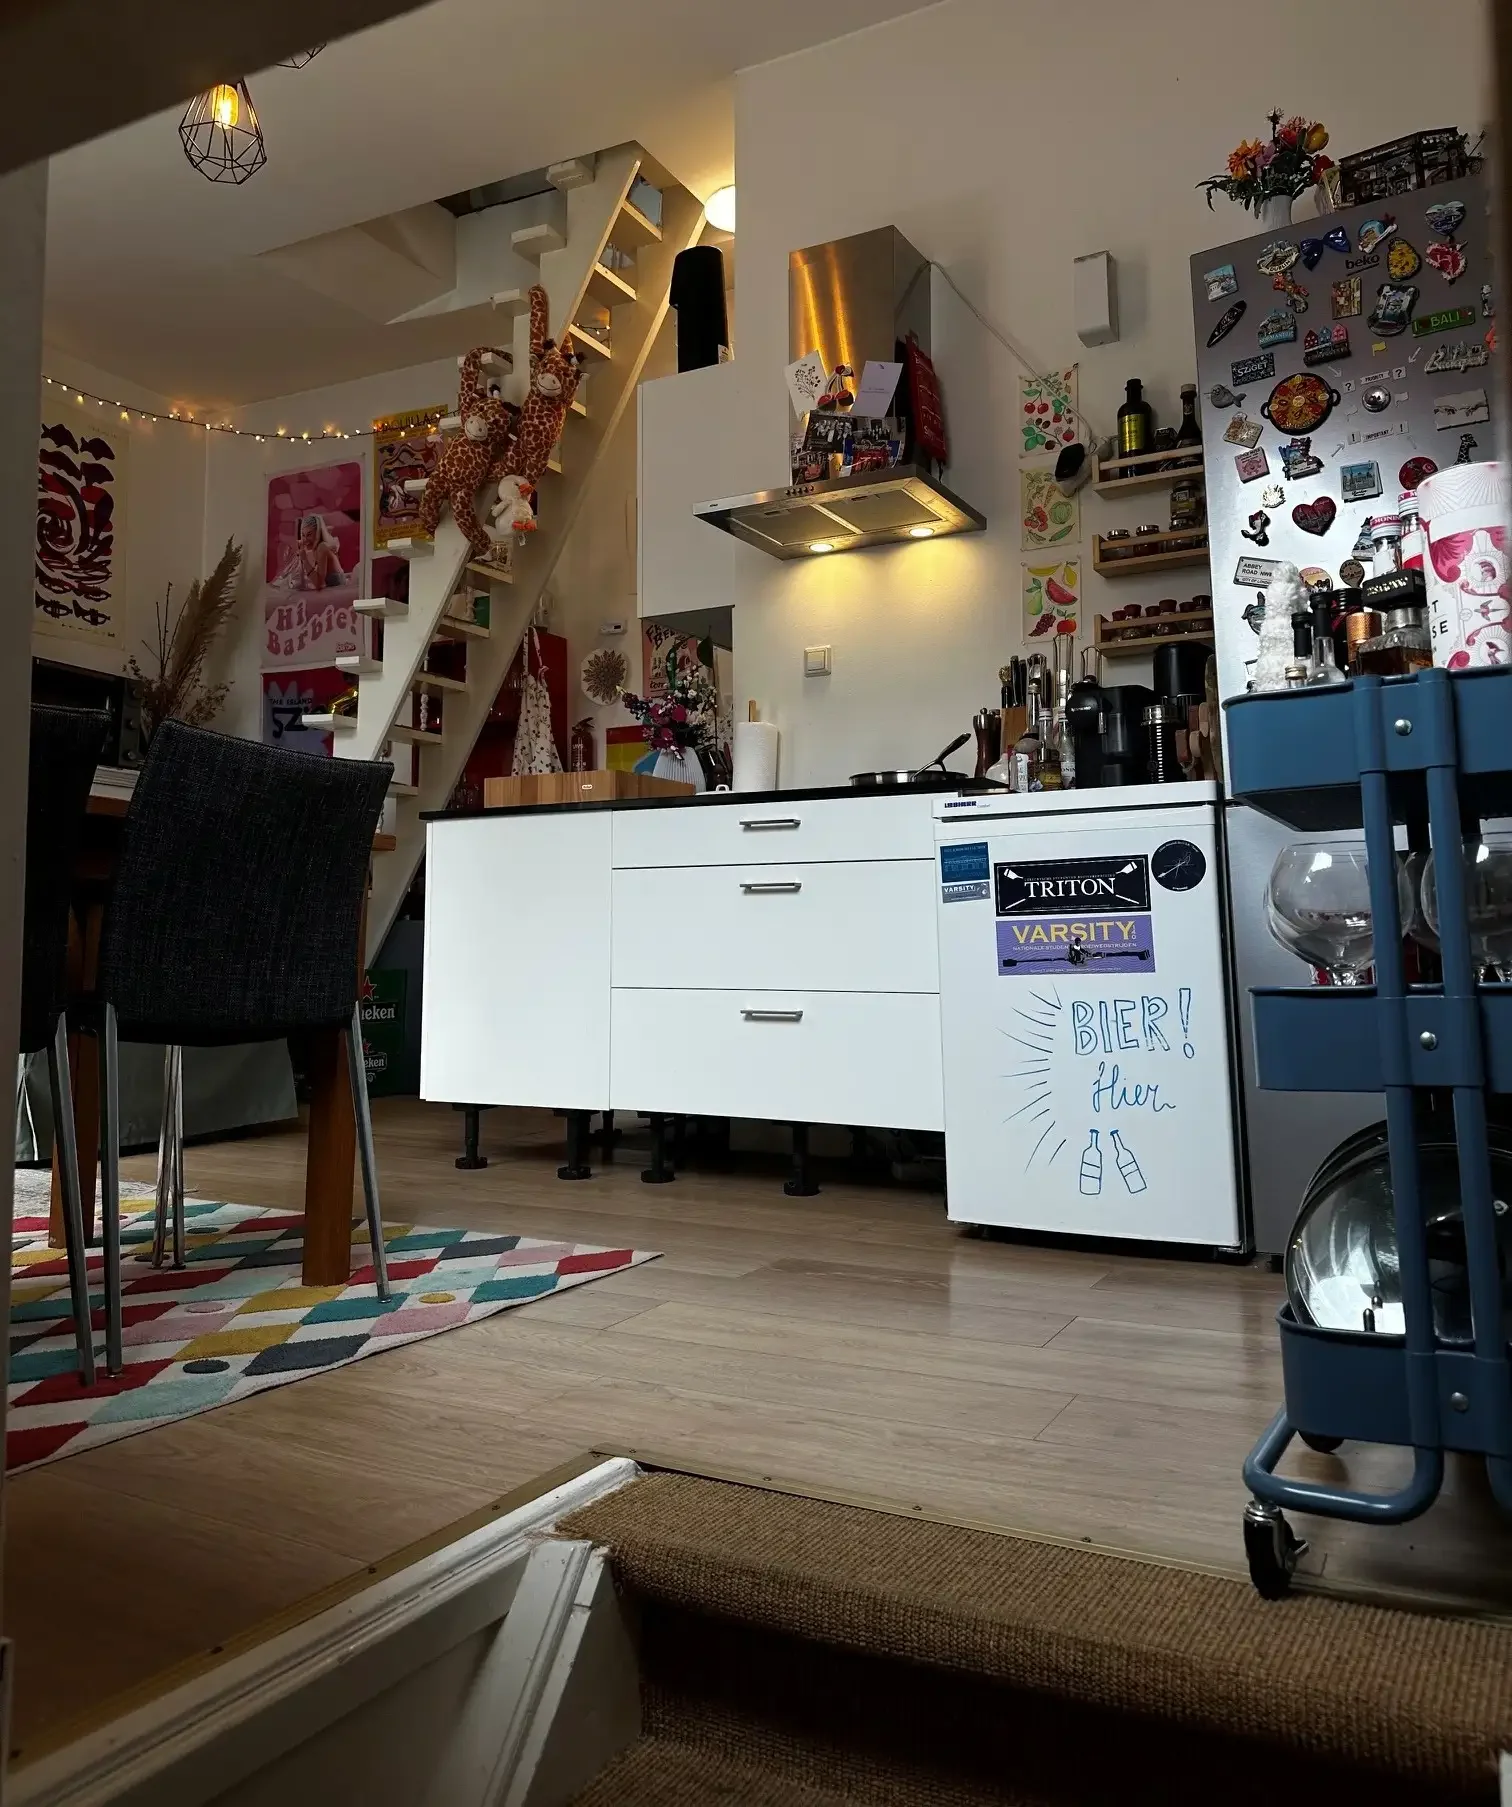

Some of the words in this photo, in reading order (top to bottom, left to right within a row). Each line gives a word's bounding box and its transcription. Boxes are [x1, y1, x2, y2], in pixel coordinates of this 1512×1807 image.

[1345, 254, 1380, 270] beko
[1430, 311, 1460, 328] BALI
[1237, 360, 1268, 377] SZIGET
[276, 602, 305, 631] Hi
[267, 609, 358, 657] Barbie!
[944, 884, 975, 894] VARSITY
[1024, 877, 1116, 898] TRITON
[1011, 920, 1136, 944] VARSITY
[361, 1005, 396, 1021] eken
[1072, 987, 1195, 1059] BIER!
[364, 1058, 385, 1068] eken
[1092, 1061, 1177, 1113] Hier
